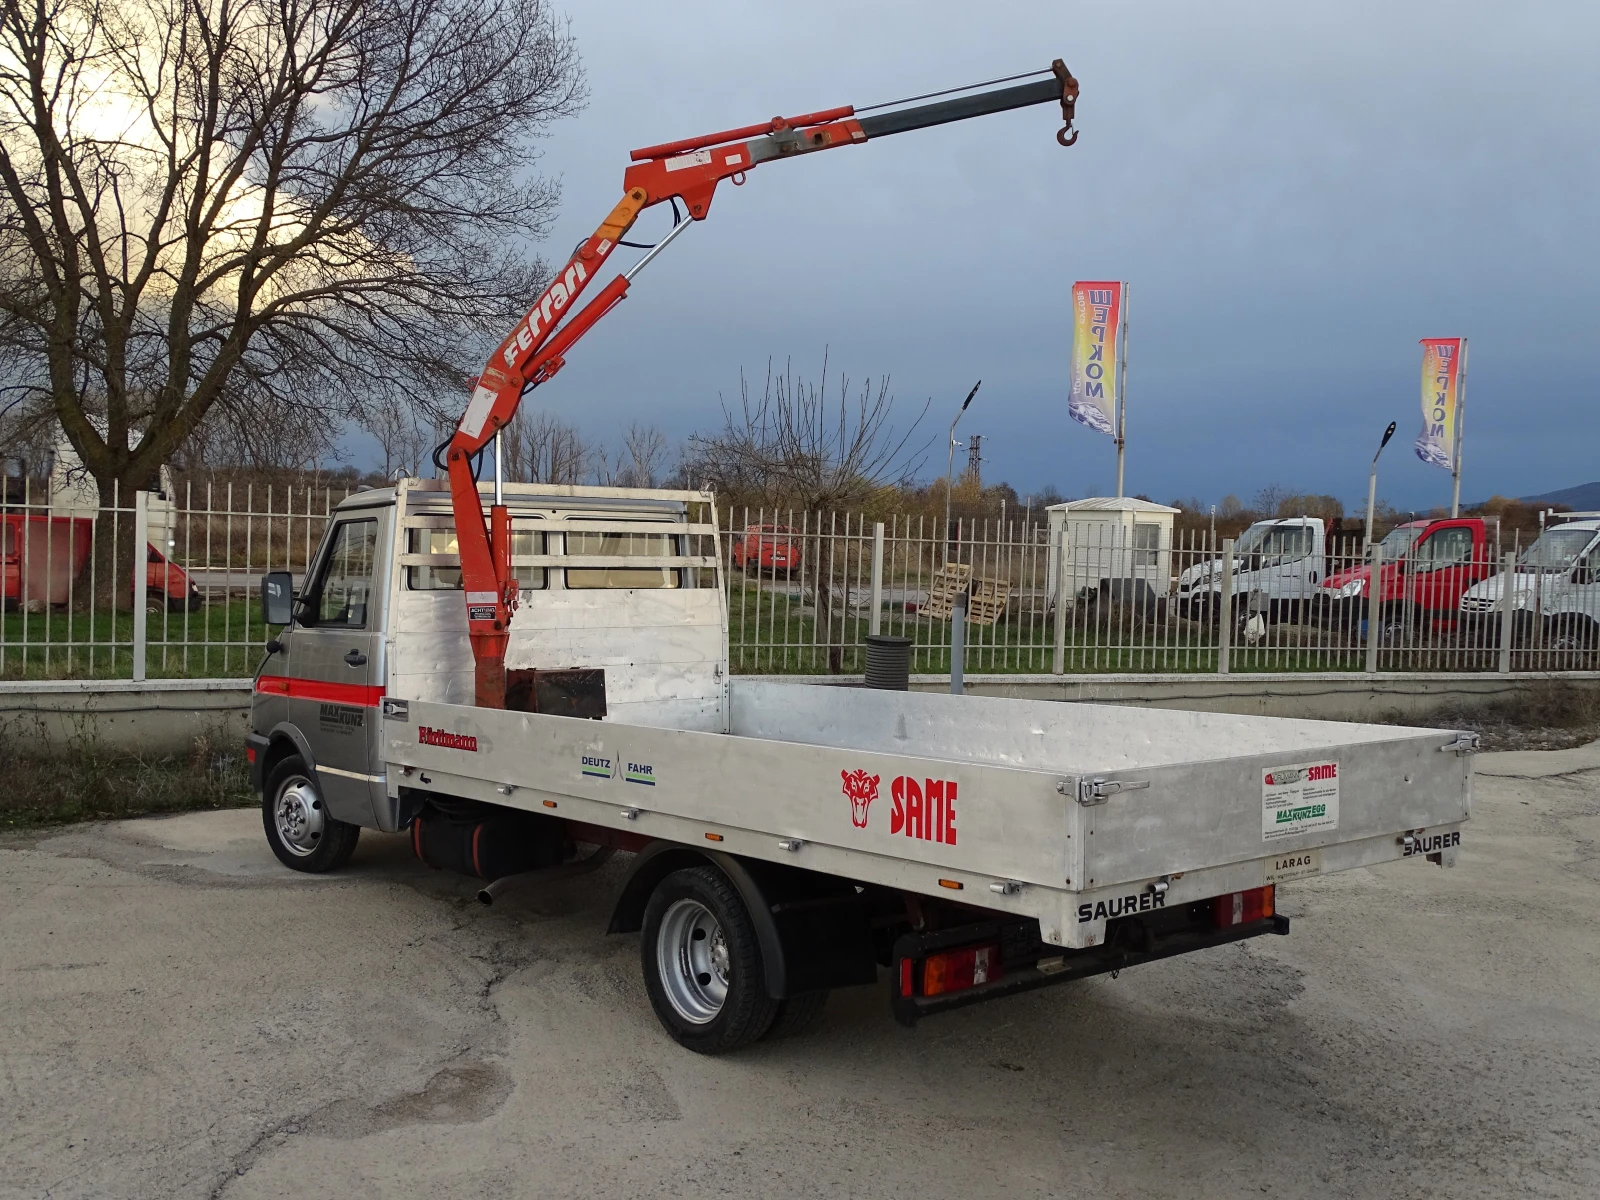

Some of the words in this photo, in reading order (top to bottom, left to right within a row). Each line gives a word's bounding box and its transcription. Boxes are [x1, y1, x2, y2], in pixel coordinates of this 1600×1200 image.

[320, 704, 341, 718] MAX
[339, 712, 364, 727] KUNZ
[581, 756, 611, 769] DEUTZ
[627, 762, 653, 775] FAHR
[1308, 763, 1337, 781] SAME
[890, 775, 958, 846] SAME
[1276, 809, 1293, 820] MAX
[1292, 809, 1312, 821] KUNZ
[1311, 803, 1326, 813] EGG
[1403, 831, 1461, 857] SAURER
[1275, 855, 1311, 871] LARAG
[1078, 890, 1166, 924] SAURER
